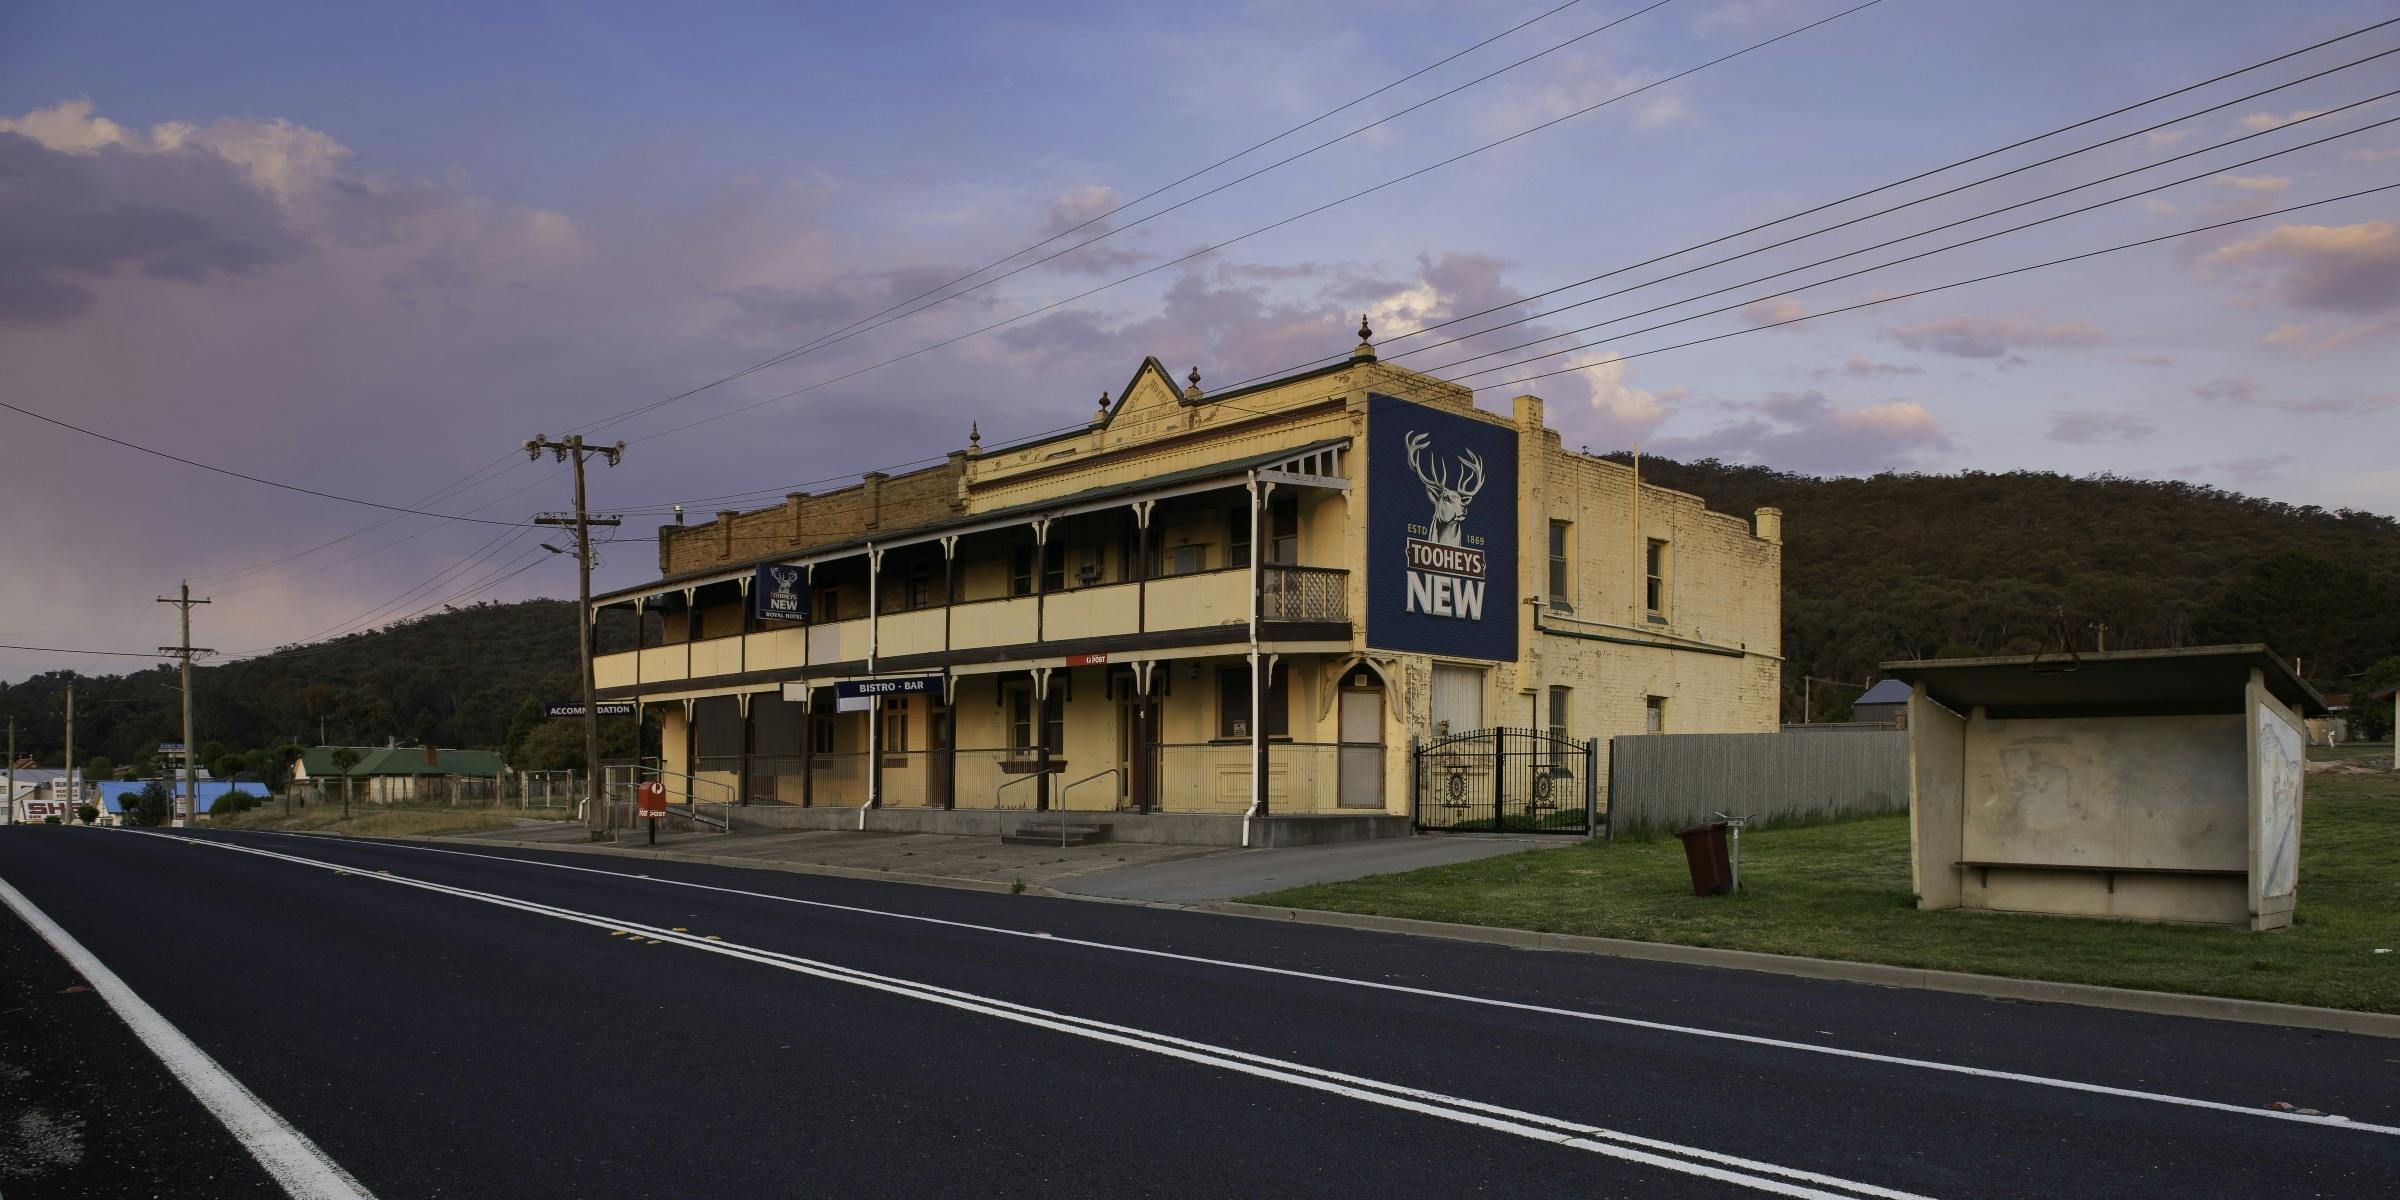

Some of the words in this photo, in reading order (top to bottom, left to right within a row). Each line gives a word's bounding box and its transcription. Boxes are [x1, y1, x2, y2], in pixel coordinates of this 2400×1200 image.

[1407, 523, 1428, 535] ESTD
[1466, 535, 1485, 546] 1869
[1411, 543, 1481, 574] TOOHEYS
[773, 592, 797, 600] TOOHEYS
[1406, 570, 1486, 620] NEW
[770, 599, 798, 611] NEW
[765, 611, 784, 619] ROYAL
[1091, 656, 1106, 664] POST
[859, 683, 895, 693] BISTRO
[904, 681, 924, 690] BAR
[550, 706, 630, 715] ACCOMDATION
